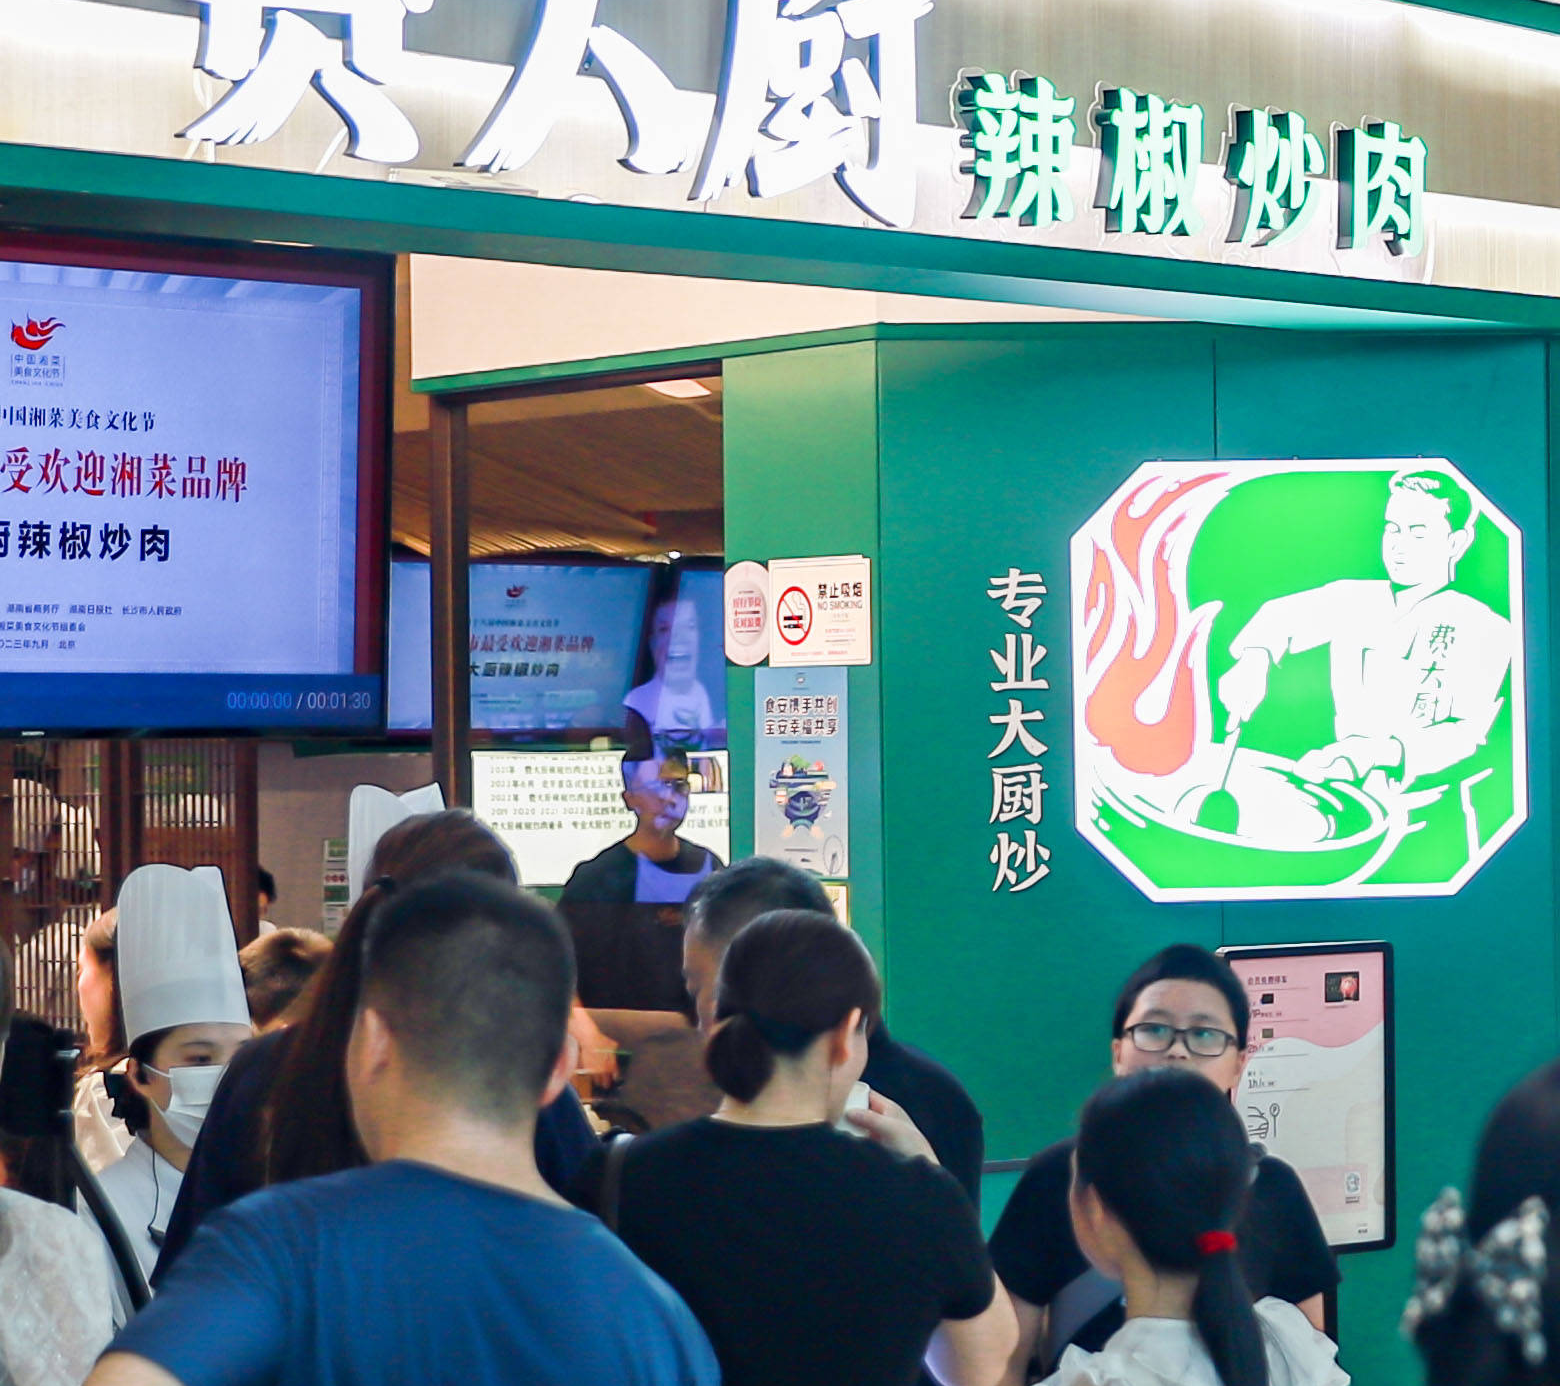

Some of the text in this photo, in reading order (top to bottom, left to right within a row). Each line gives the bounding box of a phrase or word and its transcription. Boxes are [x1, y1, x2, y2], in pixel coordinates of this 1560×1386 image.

[956, 69, 1430, 259] 辣椒炒肉
[818, 581, 863, 599] 禁止吸烟
[307, 691, 371, 711] 00:01:30
[987, 567, 1052, 893] 专业大厨炒
